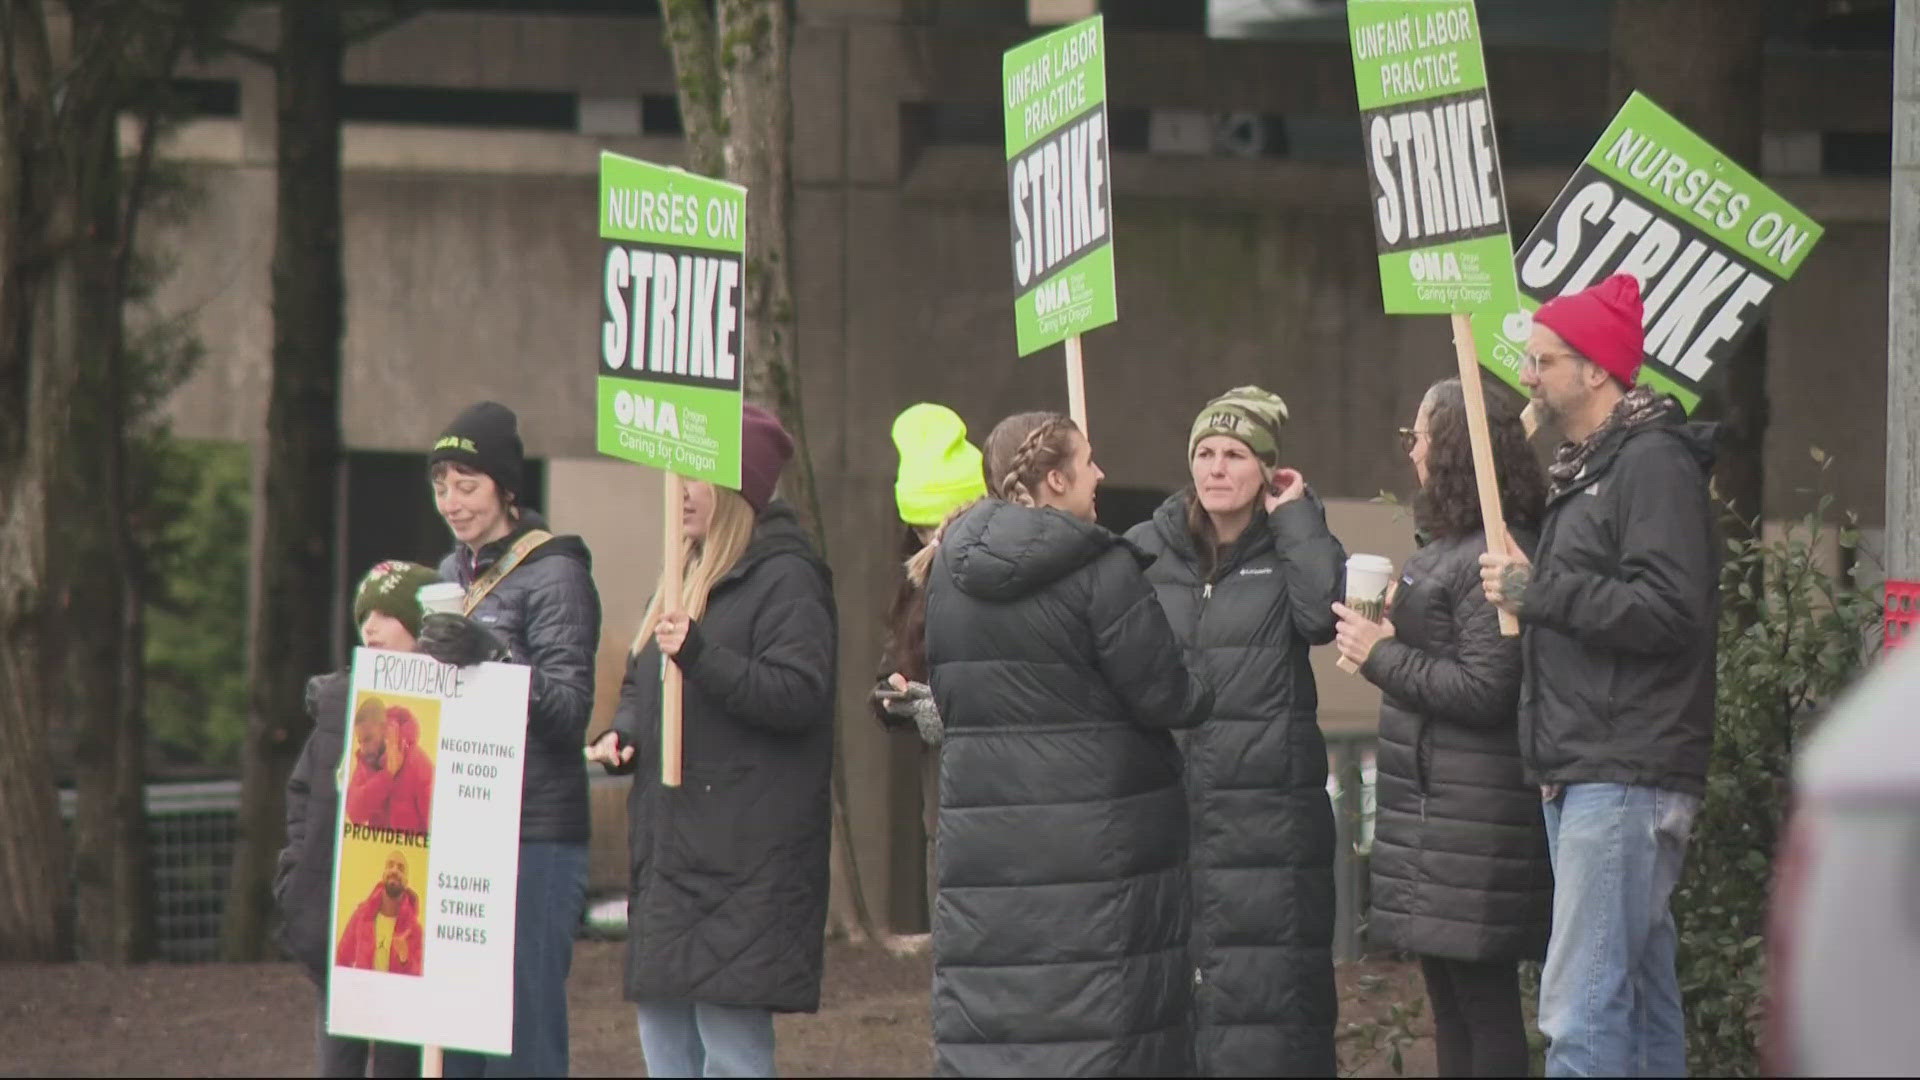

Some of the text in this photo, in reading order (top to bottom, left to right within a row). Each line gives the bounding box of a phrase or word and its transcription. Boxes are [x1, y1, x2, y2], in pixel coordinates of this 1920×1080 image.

[1355, 7, 1471, 60] UNFAIR LABOR
[1008, 25, 1097, 109] UNFAIR LABOR
[1381, 50, 1461, 99] PRACTICE
[1025, 72, 1086, 140] PRACTICE
[1371, 98, 1500, 245] STRIKE
[609, 187, 738, 240] NURSES ON
[1013, 113, 1105, 287] STRIKE
[1605, 127, 1809, 266] NURSES ON
[1409, 252, 1462, 281] ONA
[602, 246, 739, 380] STRIKE
[1035, 277, 1071, 317] ONA
[1417, 286, 1491, 304] Caring for Oregon
[614, 390, 680, 440] ONA
[1209, 412, 1242, 431] CAT
[620, 431, 715, 471] Caring for Oregon
[373, 654, 464, 698] PROVIDENCE
[441, 737, 515, 758] NEGOTIATING
[451, 762, 498, 778] IN GOOD
[458, 784, 491, 800] FAITH
[343, 822, 431, 848] PROVIDENCE
[438, 872, 490, 893] $110/HR
[440, 899, 485, 918] STRIKE
[437, 924, 487, 944] NURSES
